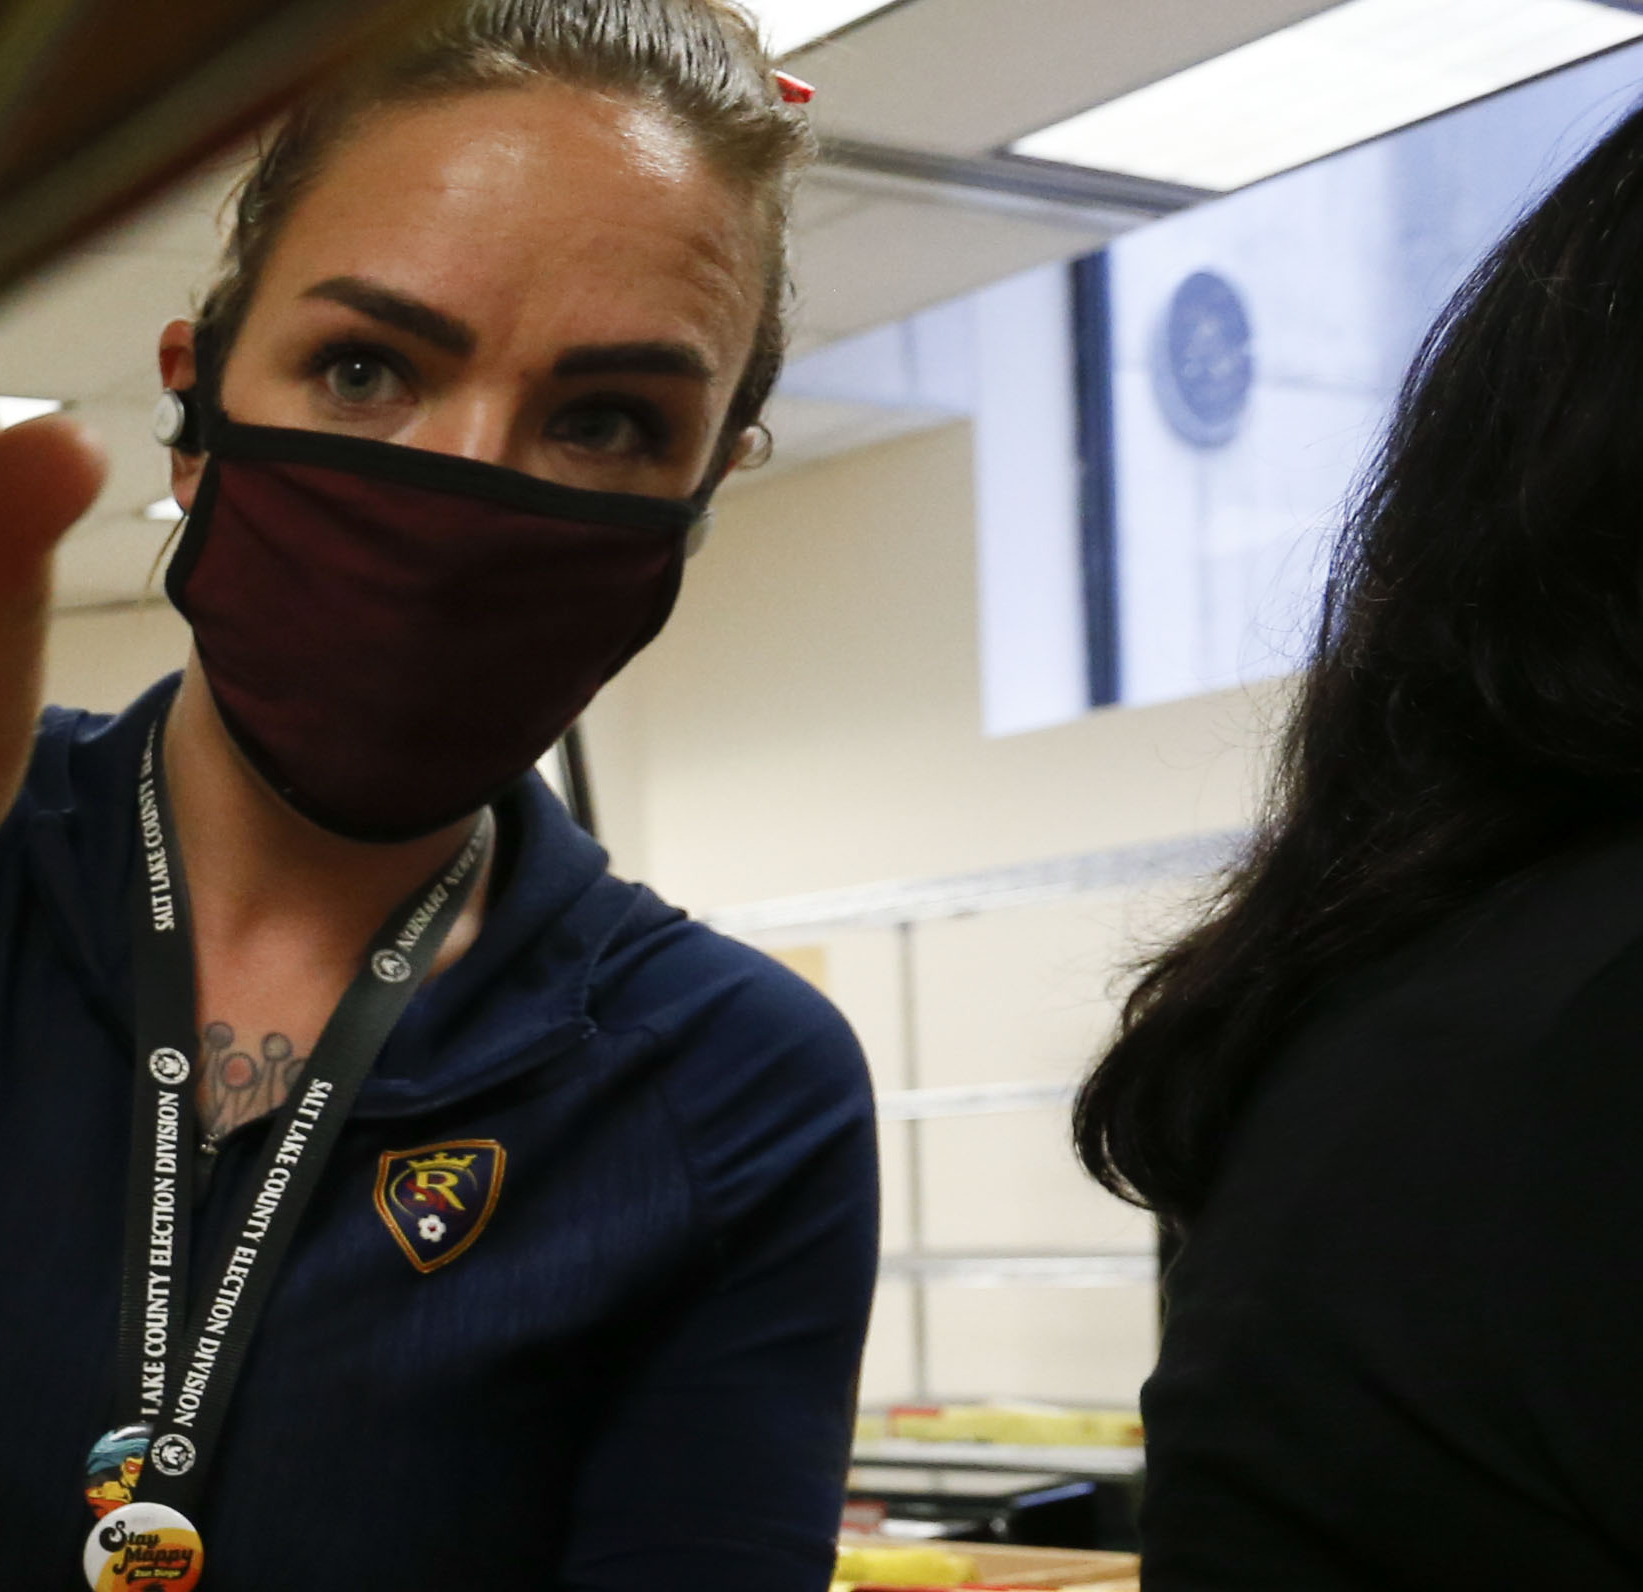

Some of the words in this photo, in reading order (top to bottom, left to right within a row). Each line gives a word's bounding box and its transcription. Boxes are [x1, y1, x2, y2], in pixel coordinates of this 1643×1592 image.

[138, 778, 163, 848] COUNTY
[146, 847, 171, 893] LAKE
[151, 894, 175, 931] SALT
[155, 1090, 179, 1173] DIVISION
[297, 1078, 333, 1121] SALT
[275, 1119, 314, 1167] LAKE
[150, 1176, 175, 1267] ELECTION
[242, 1167, 291, 1243] COUNTY
[144, 1271, 171, 1358] COUNTY
[205, 1245, 258, 1335] ELECTION
[172, 1336, 222, 1428] DIVISION
[99, 1520, 160, 1553] Stay
